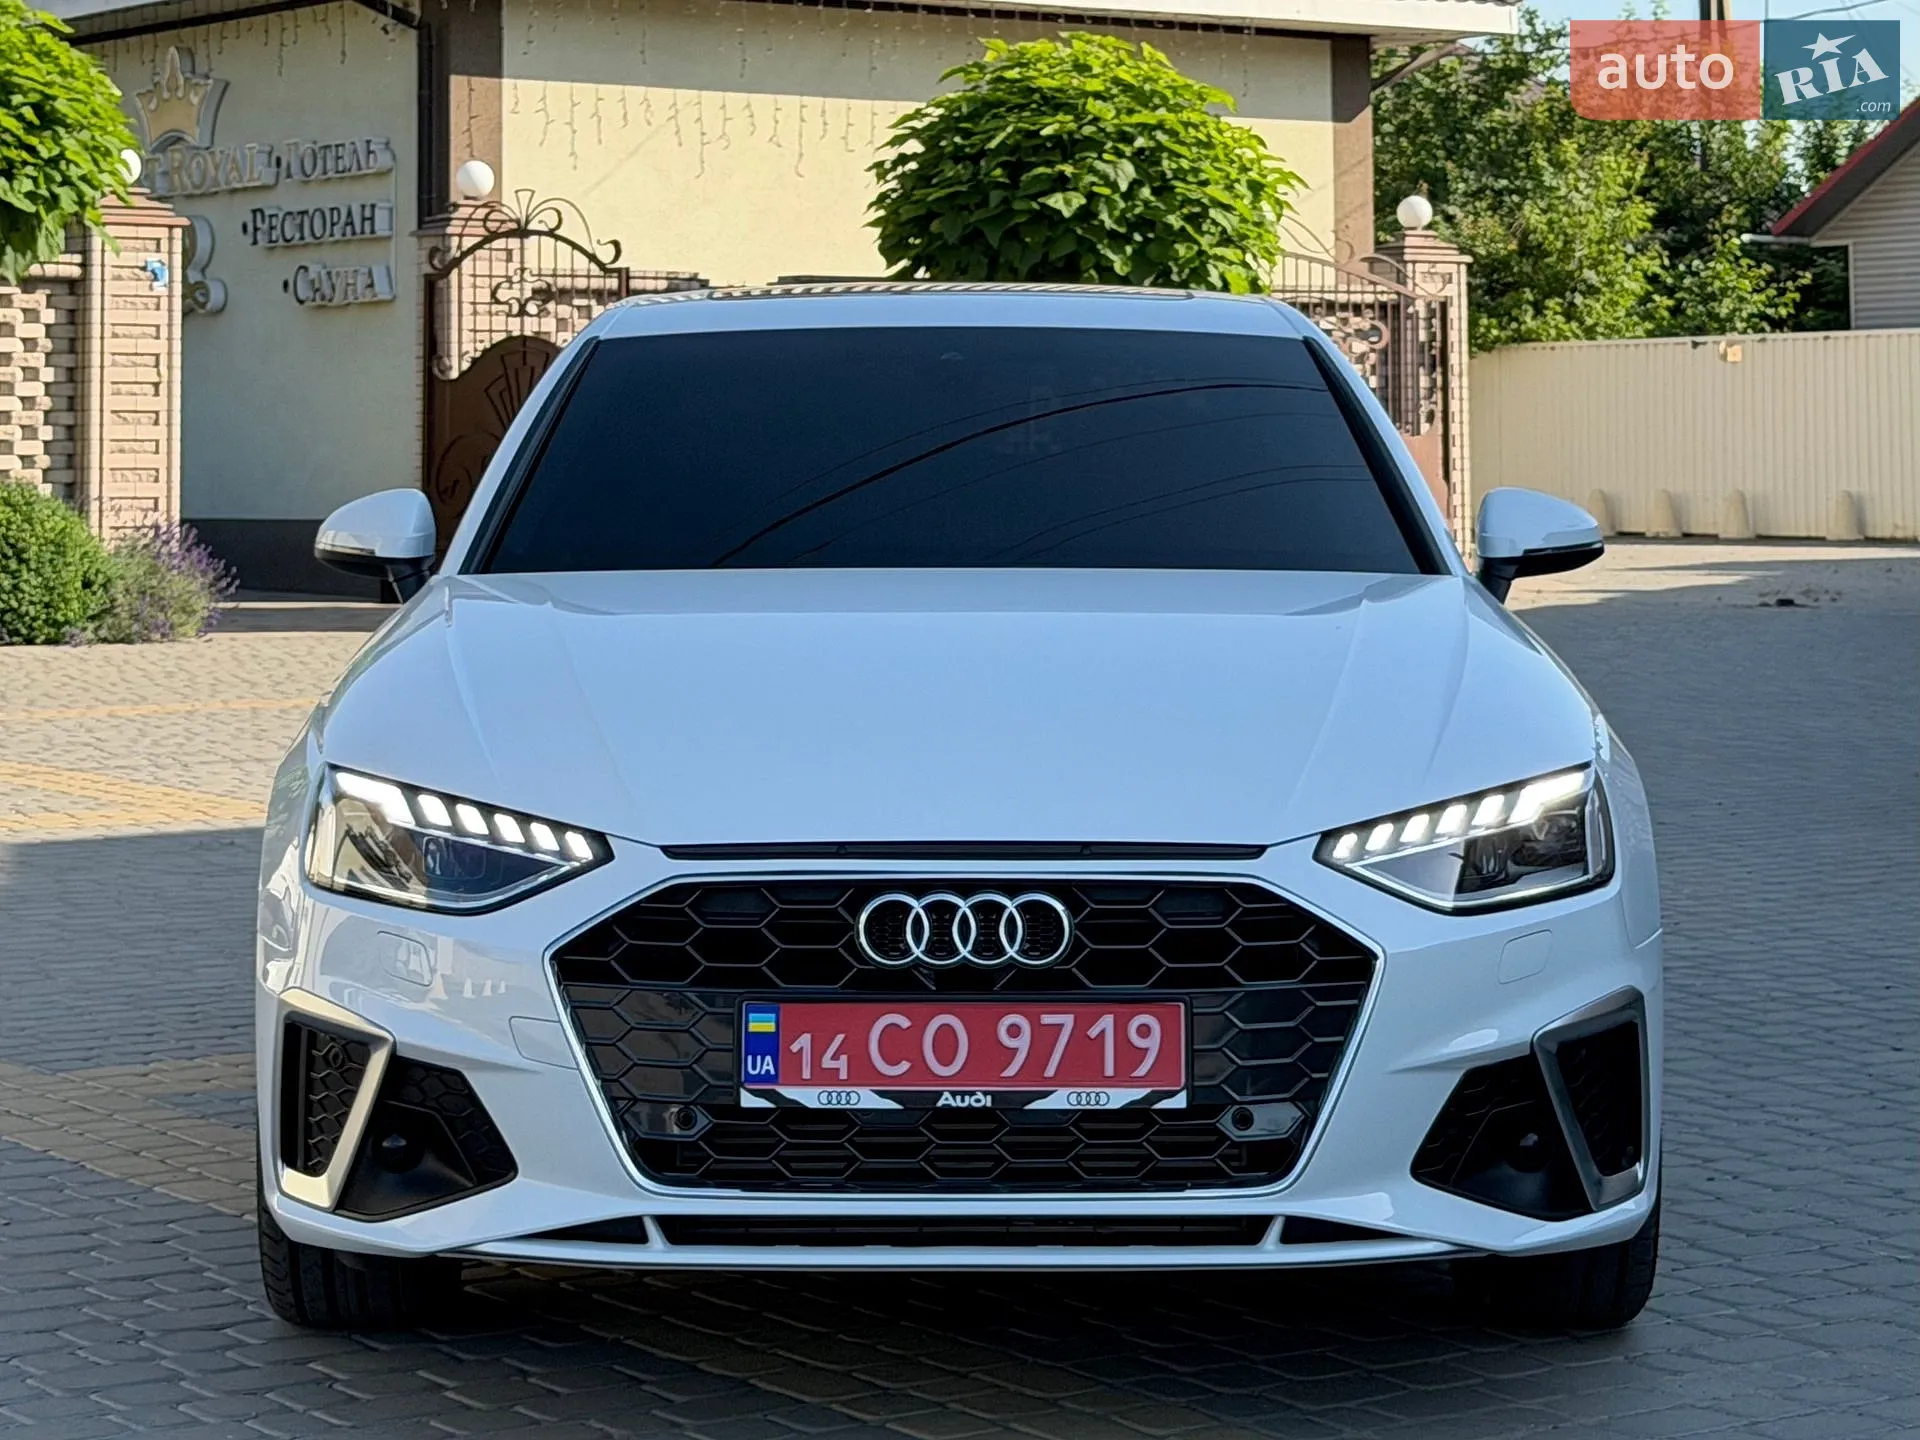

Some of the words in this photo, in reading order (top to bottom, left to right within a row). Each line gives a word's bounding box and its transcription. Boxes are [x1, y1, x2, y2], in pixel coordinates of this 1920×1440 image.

[167, 143, 265, 194] ROYAL
[250, 203, 377, 246] РЕСТОРАН
[292, 264, 379, 305] САУНА
[747, 1055, 775, 1076] UA
[789, 1033, 849, 1081] 14
[867, 1013, 970, 1078] CO
[996, 1013, 1163, 1079] 9719
[936, 1090, 992, 1108] Audi
